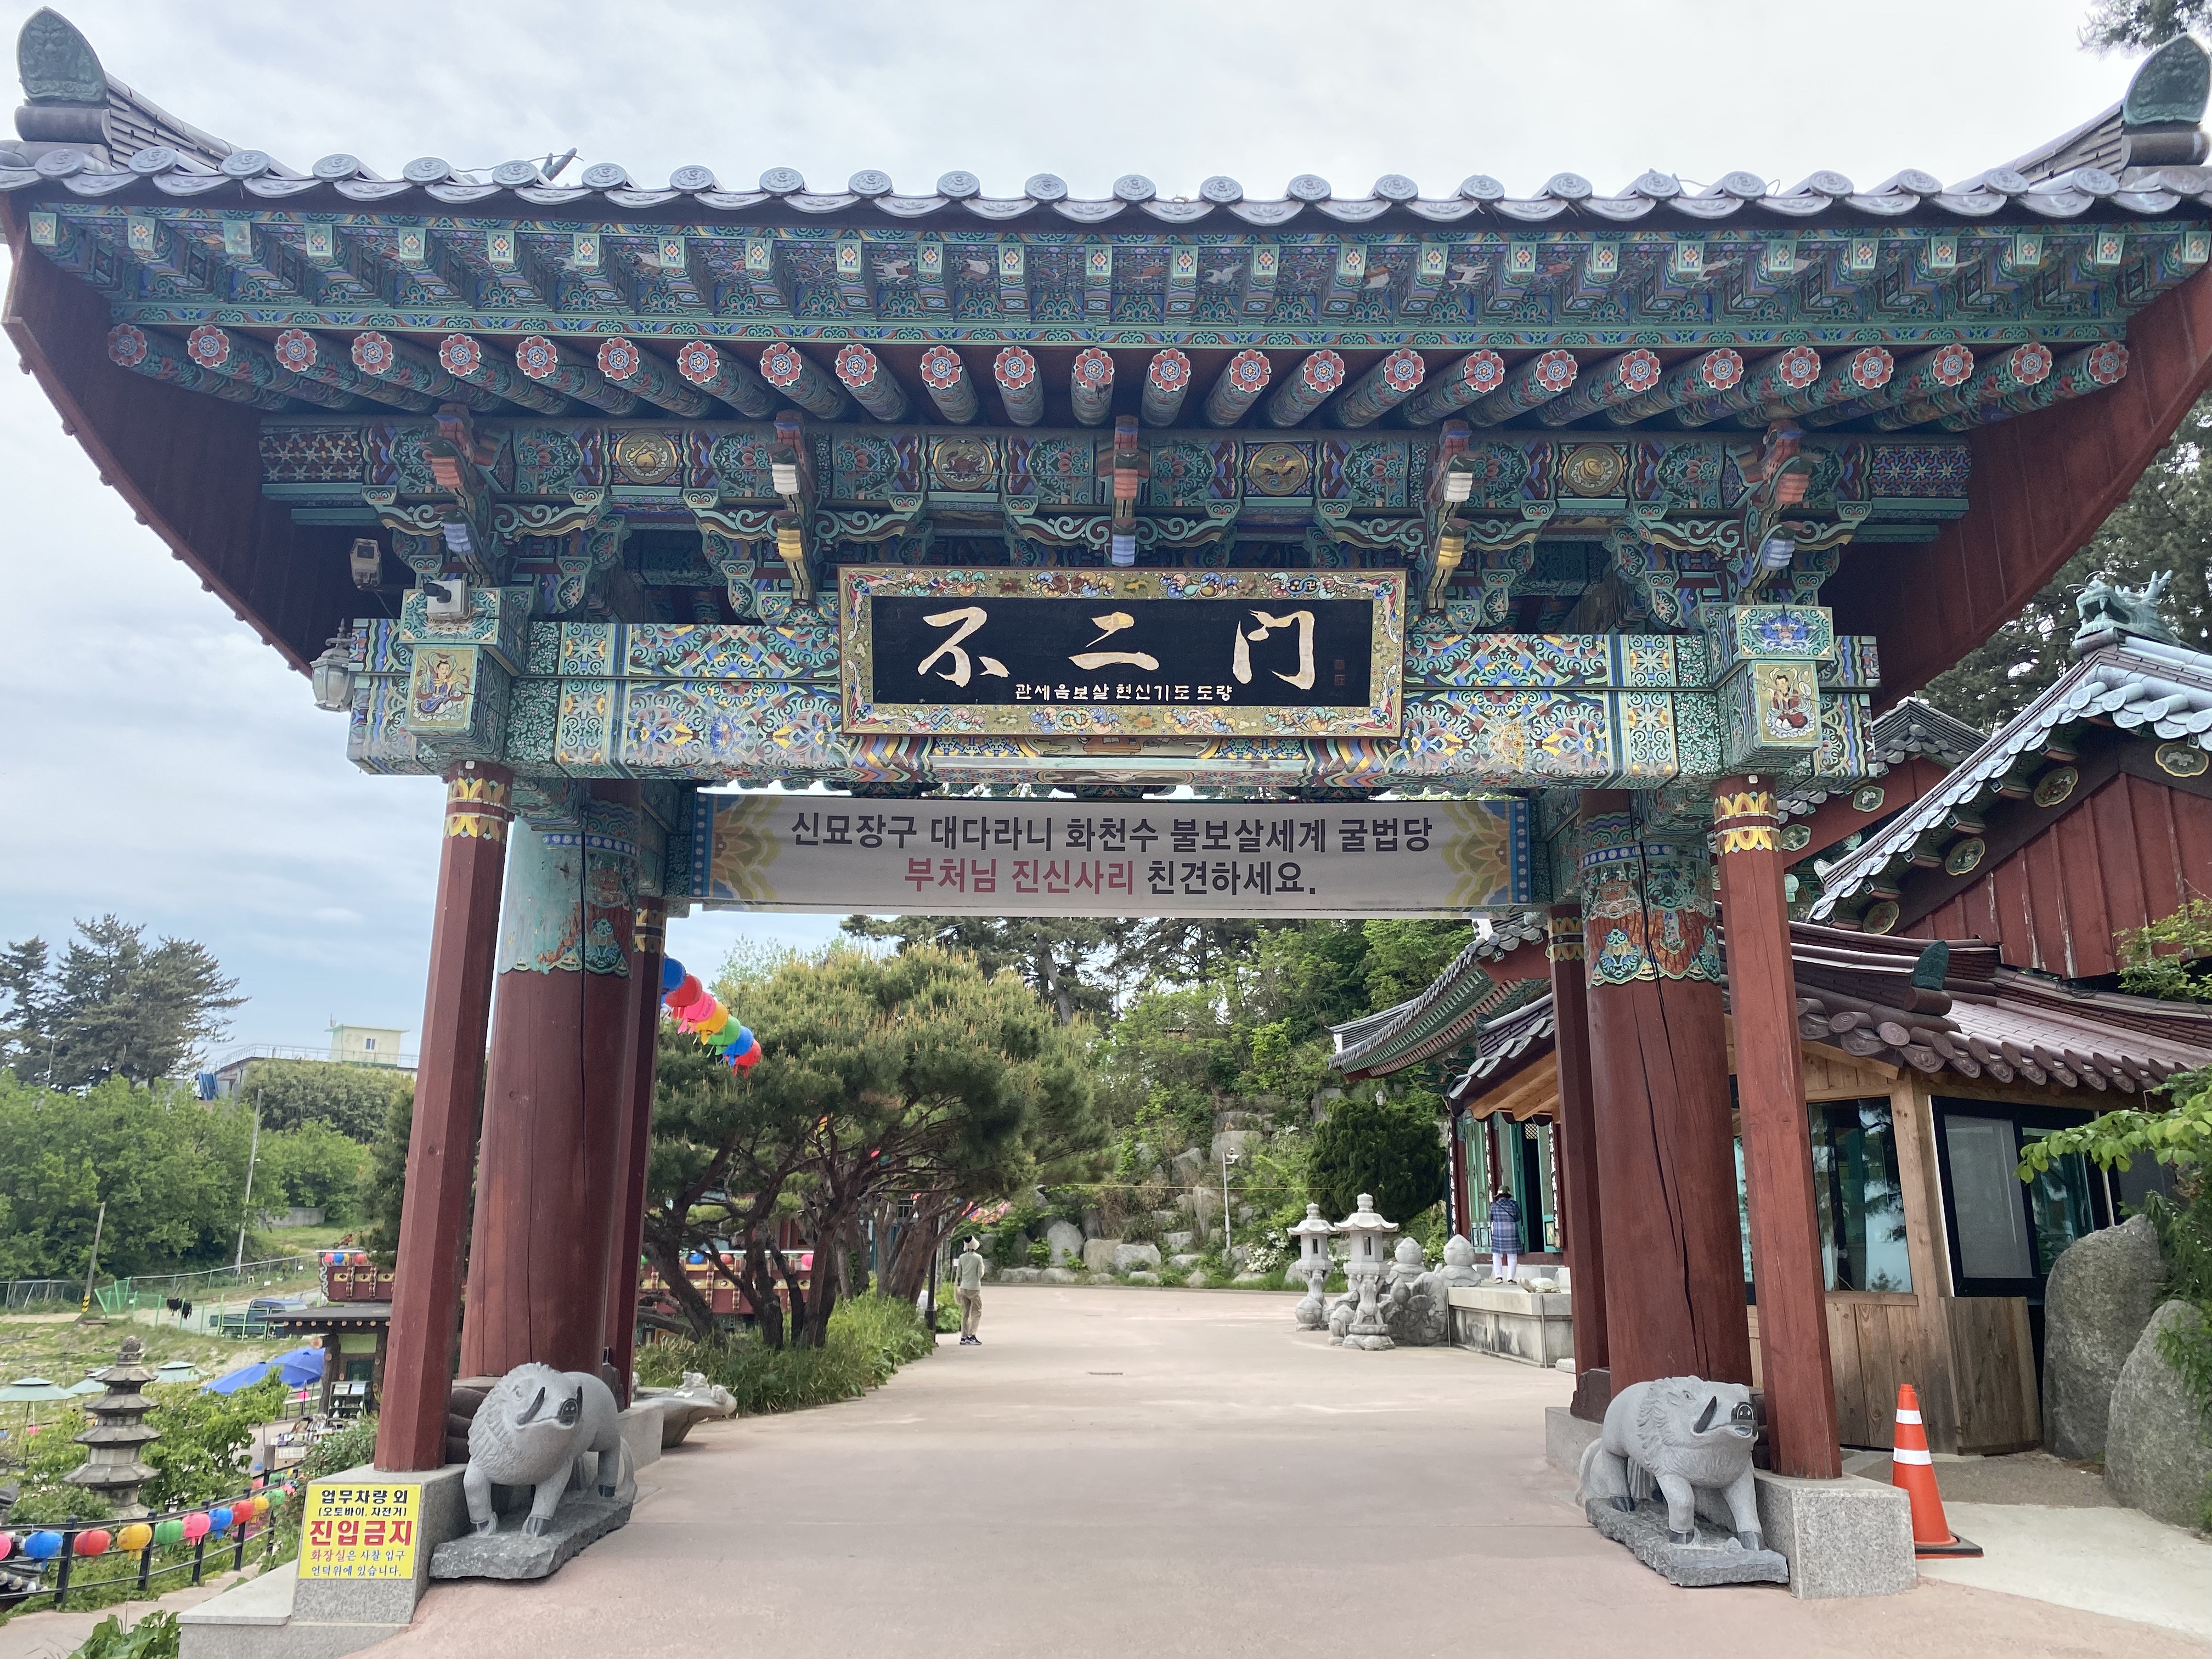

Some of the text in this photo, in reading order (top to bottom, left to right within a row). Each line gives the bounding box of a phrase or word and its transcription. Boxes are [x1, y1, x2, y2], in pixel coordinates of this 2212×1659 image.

[1015, 683, 1232, 702] 관세음보살 현신기도 도량
[791, 812, 1432, 853] 신묘장구 대다라니 화천수 불보살세계 굴법당
[904, 857, 1316, 896] 부처님 진신사리 친견하세요.
[321, 1490, 408, 1504] 업무차량 외
[309, 1520, 412, 1546] 진입금지
[311, 1549, 405, 1562] 화장실은 사찰 입구
[311, 1565, 352, 1577] 언덕위에
